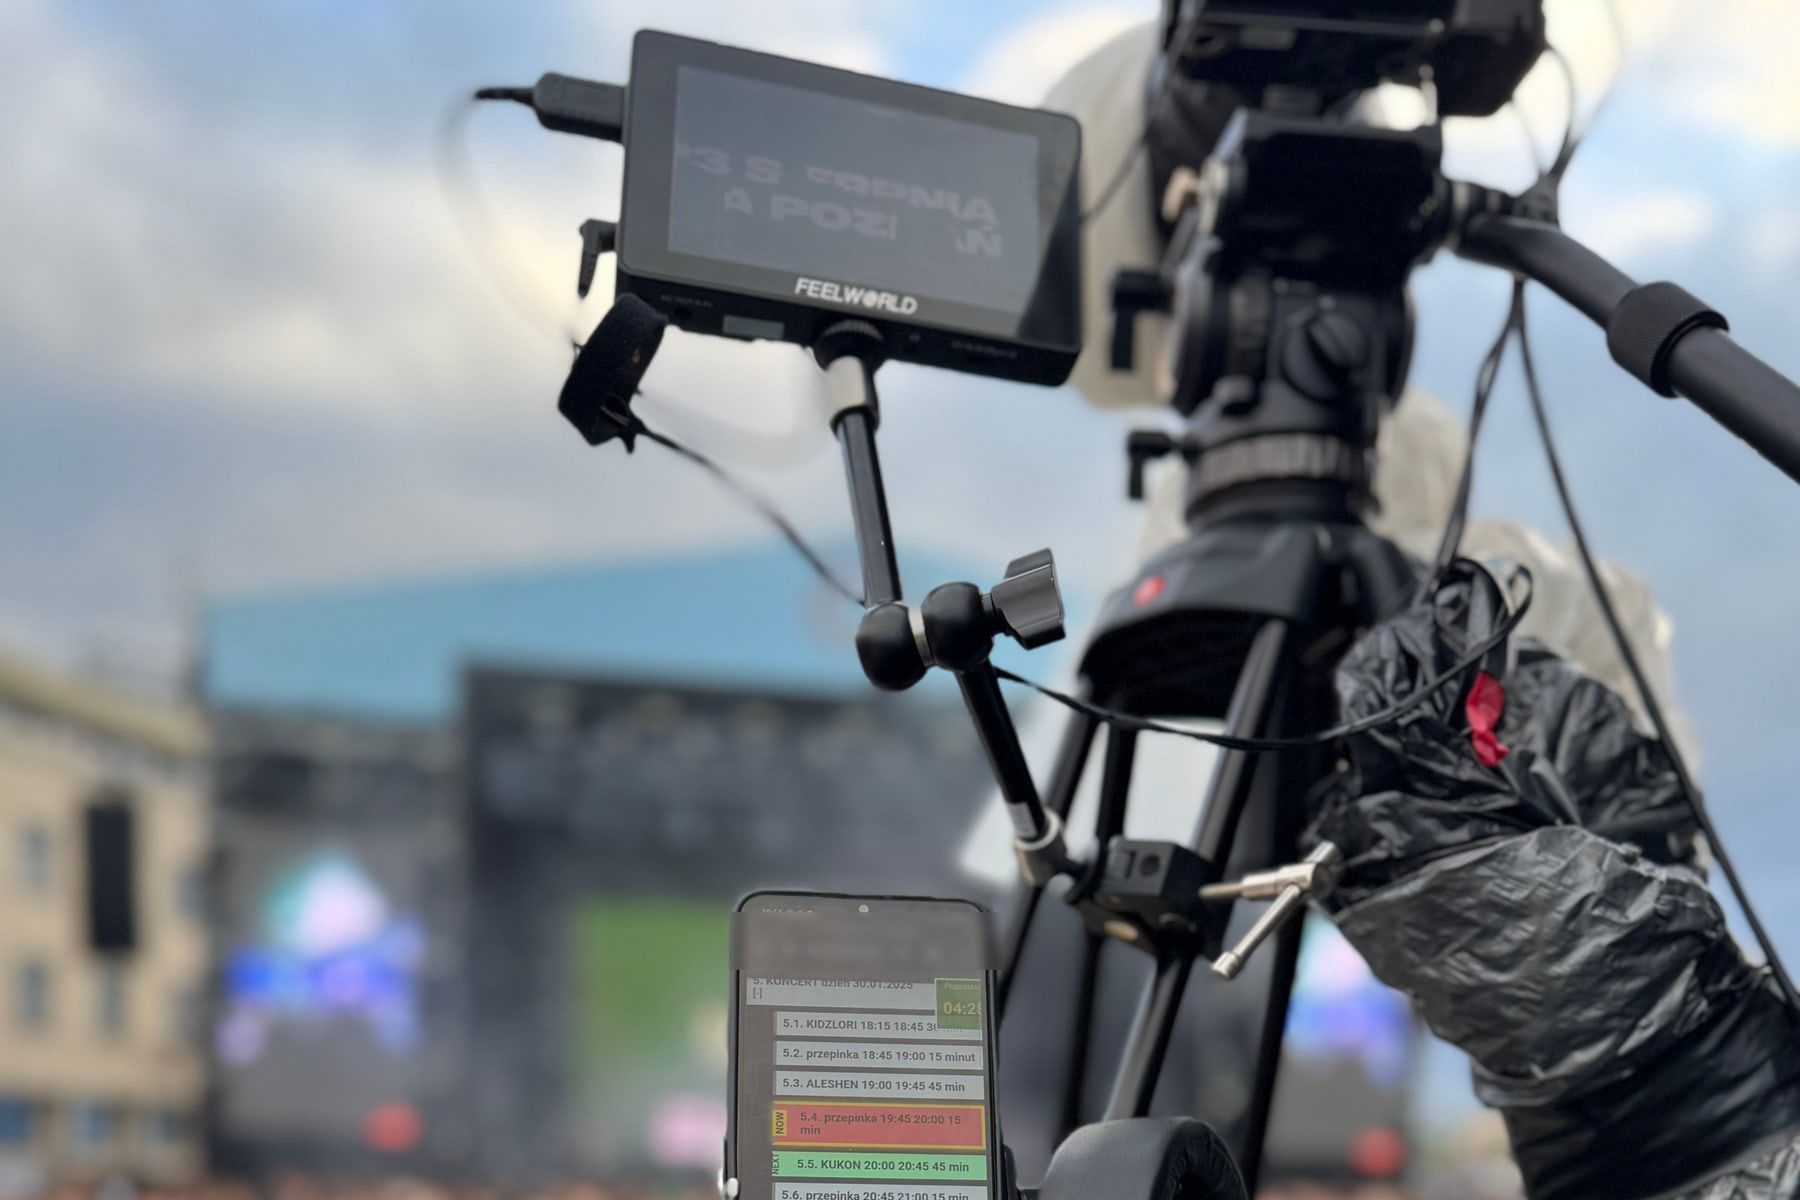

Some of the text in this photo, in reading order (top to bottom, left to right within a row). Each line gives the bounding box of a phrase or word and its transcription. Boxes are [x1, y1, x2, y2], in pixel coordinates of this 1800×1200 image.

[794, 278, 917, 315] FEELWORLD
[783, 1019, 803, 1028] 5.1.
[807, 1019, 857, 1030] KIDZLORI
[861, 1021, 890, 1031] 18:15
[894, 1022, 923, 1031] 18:45
[783, 1049, 975, 1062] 5.2. przepinka 18:45 19:00 15 minut
[783, 1079, 965, 1092] 5.3. ALESHEN 19:00 19:45 45 min
[776, 1112, 784, 1134] NOW
[801, 1112, 961, 1125] 5.4. przepinka 19:45 20:00 15
[801, 1126, 820, 1134] min
[797, 1159, 969, 1172] 5.5. KUKON 20:00 20:45 45 min
[782, 1191, 802, 1200] 5.6.
[863, 1192, 894, 1200] 20:45
